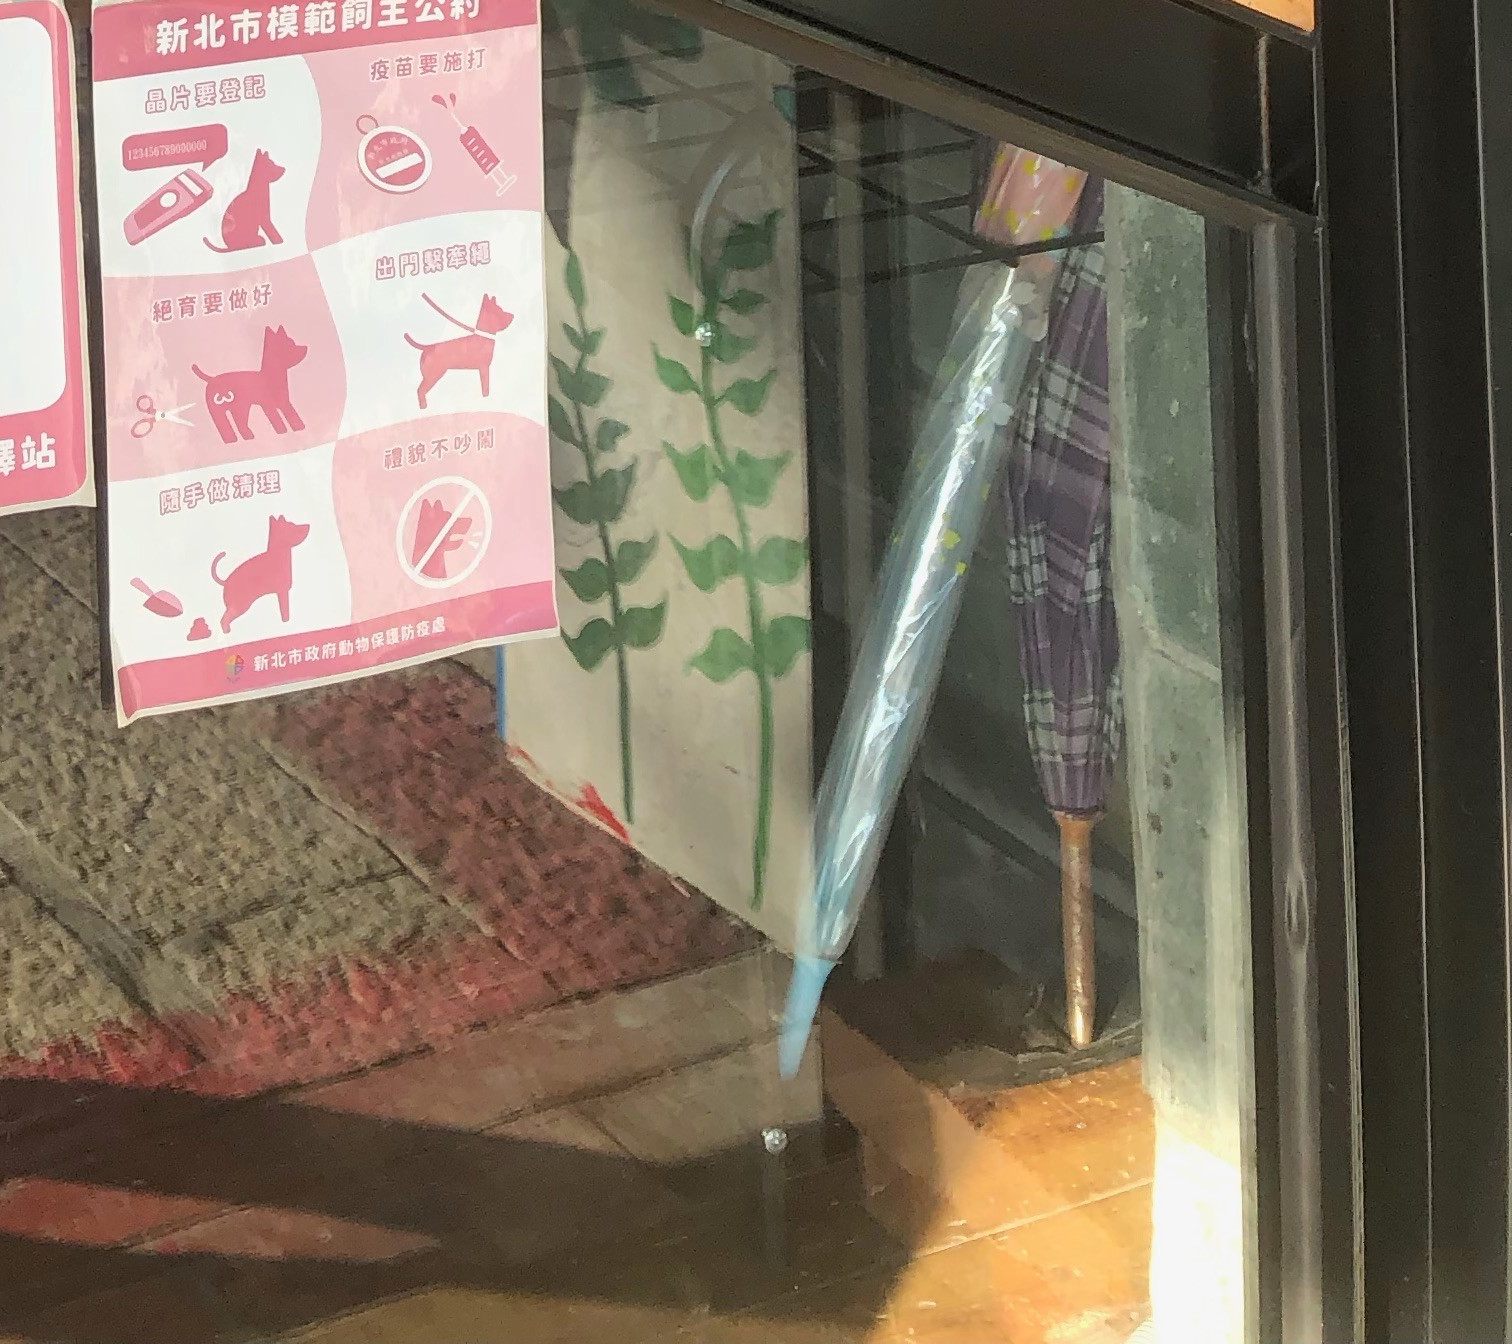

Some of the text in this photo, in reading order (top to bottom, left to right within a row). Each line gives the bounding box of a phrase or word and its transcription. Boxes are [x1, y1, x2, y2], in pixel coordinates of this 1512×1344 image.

[369, 46, 488, 82] 疫苗要施打
[144, 73, 267, 115] 晶片要登記
[151, 282, 273, 324] 絕育要做好
[383, 427, 495, 470] 禮貌不吵鬧
[158, 468, 282, 516] 隨手做清理
